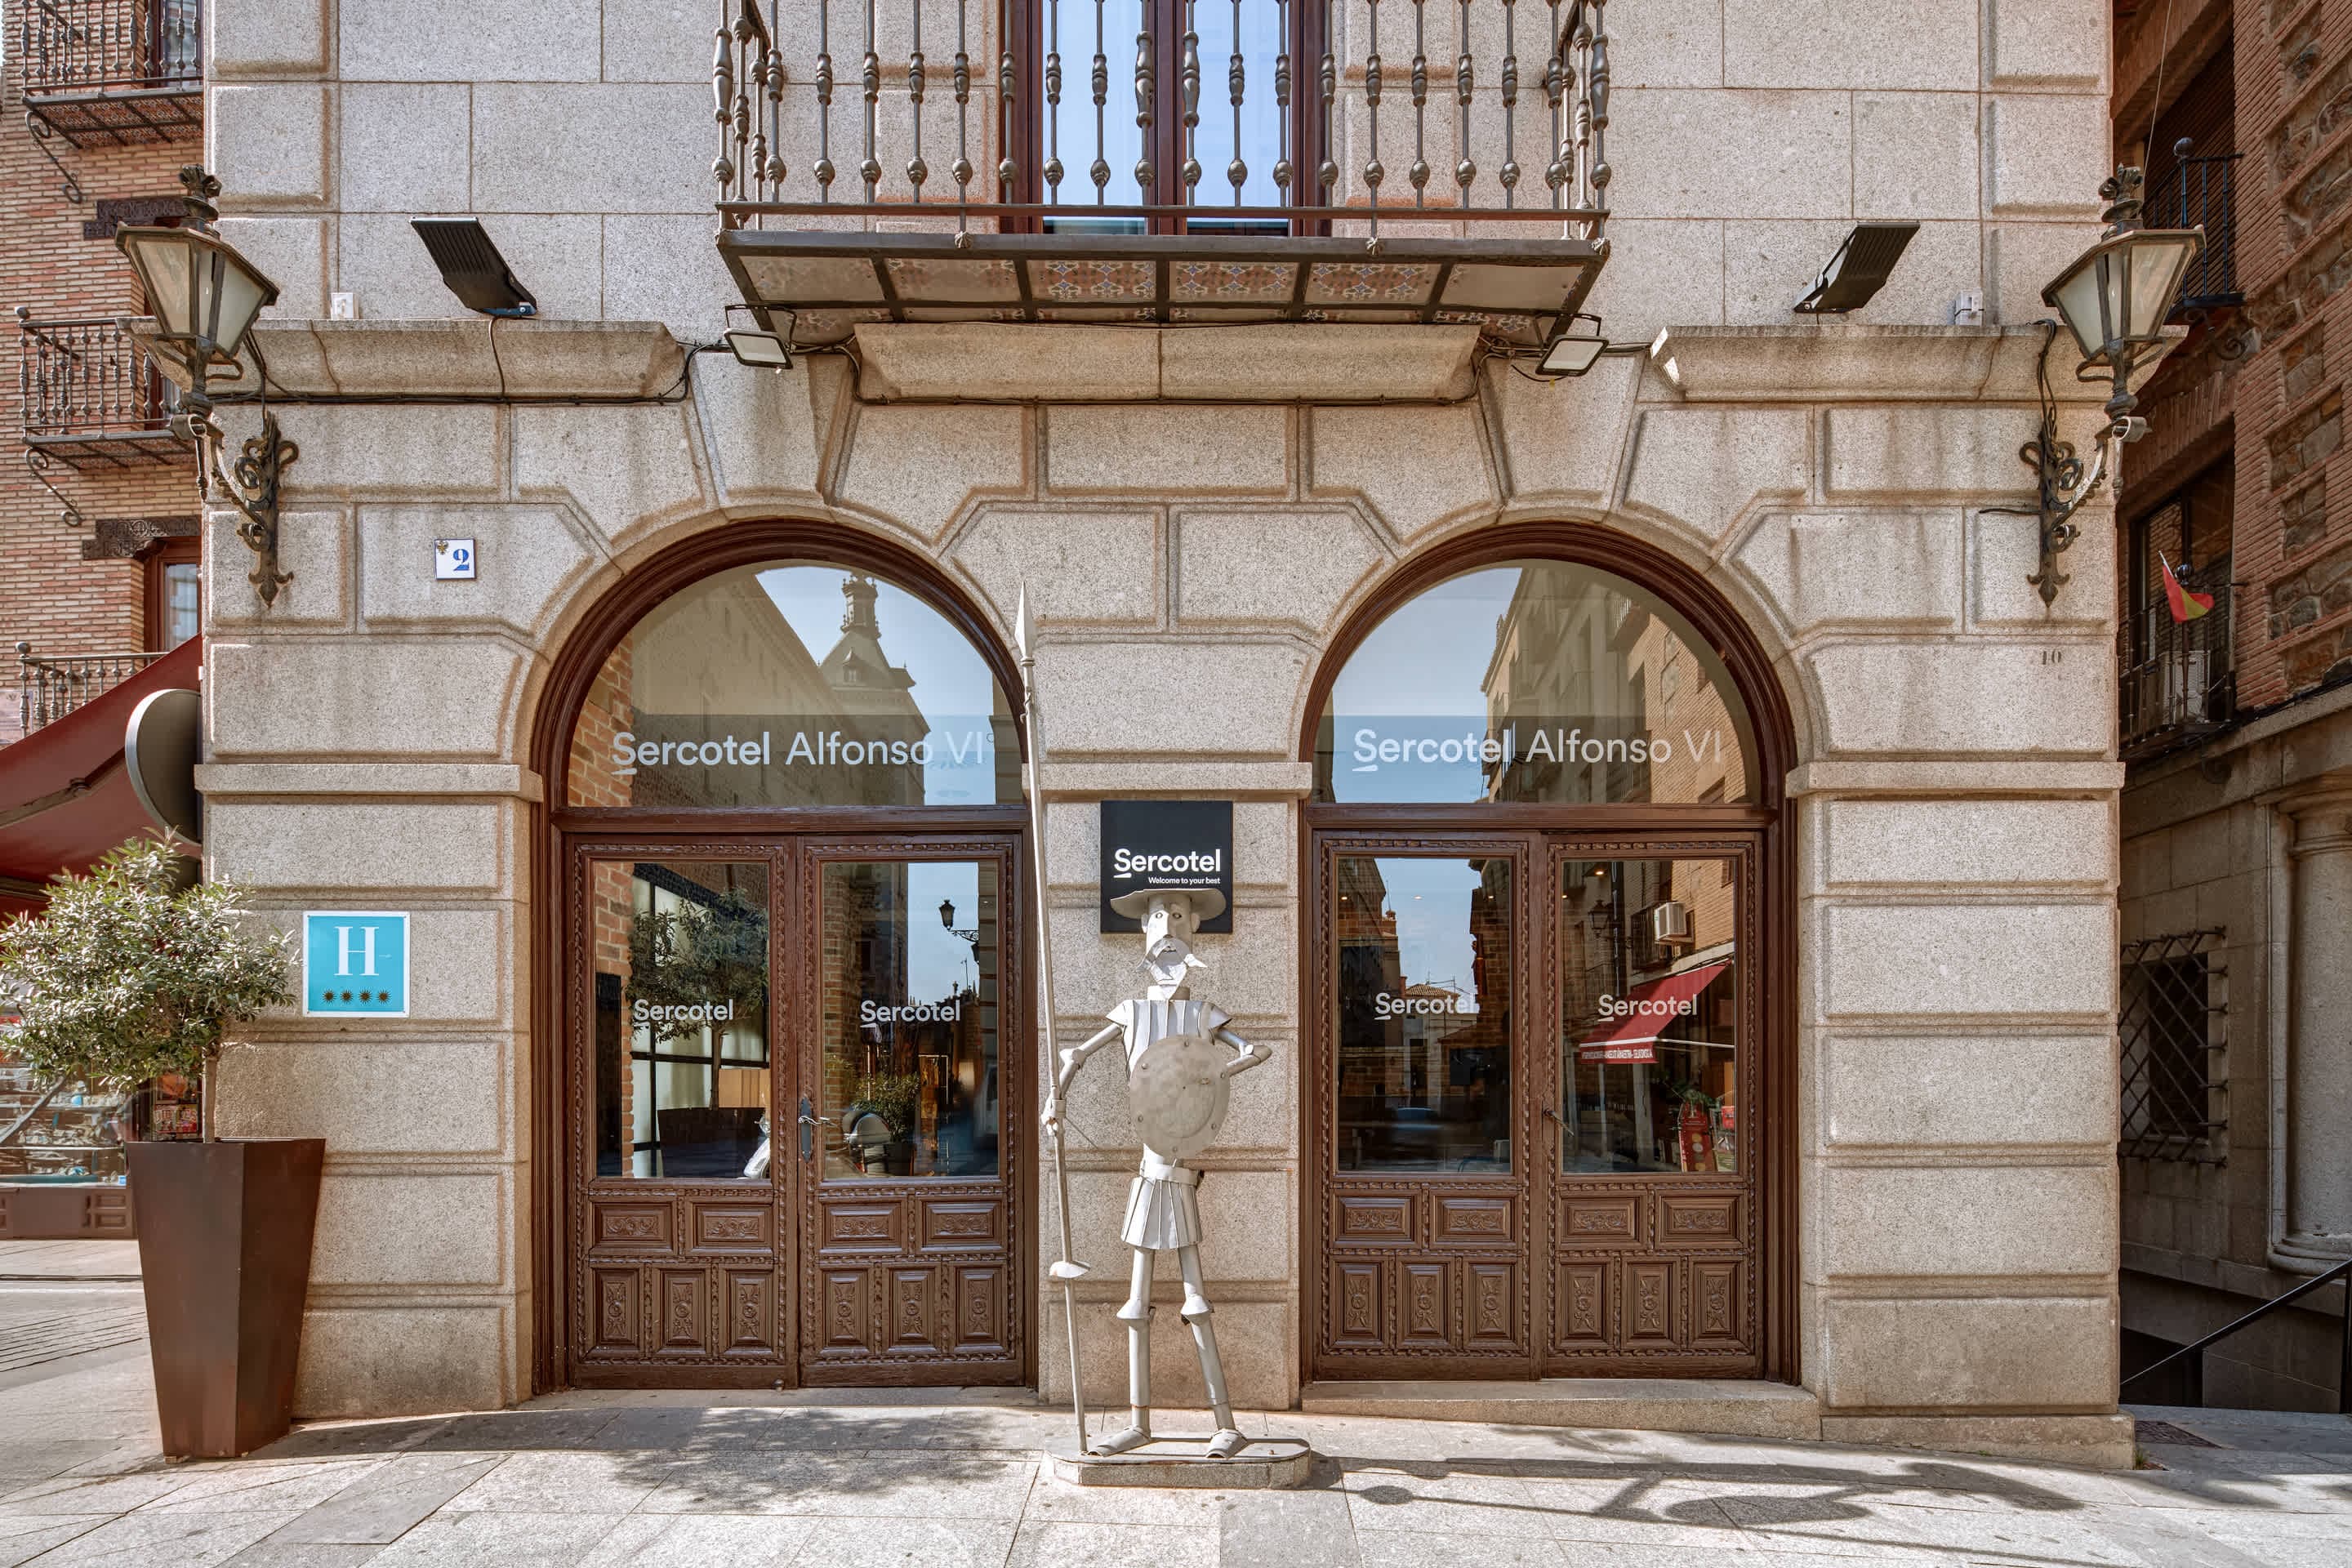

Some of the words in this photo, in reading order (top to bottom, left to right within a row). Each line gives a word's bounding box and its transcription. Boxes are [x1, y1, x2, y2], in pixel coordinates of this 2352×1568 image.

[452, 549, 470, 571] 2
[612, 732, 770, 775] Sercotel
[786, 731, 933, 765] Alfonso
[940, 732, 984, 764] VI
[1352, 729, 1510, 772] Sercotel
[1526, 729, 1672, 764] Alfonso
[1683, 731, 1721, 762] VI
[1114, 849, 1221, 878] Sercotel
[1190, 878, 1205, 886] your
[334, 926, 380, 976] H
[633, 999, 734, 1028] Sercotel
[860, 1000, 960, 1029] Sercotel
[1374, 993, 1477, 1020] Sercotel
[1597, 995, 1698, 1022] Sercotel
